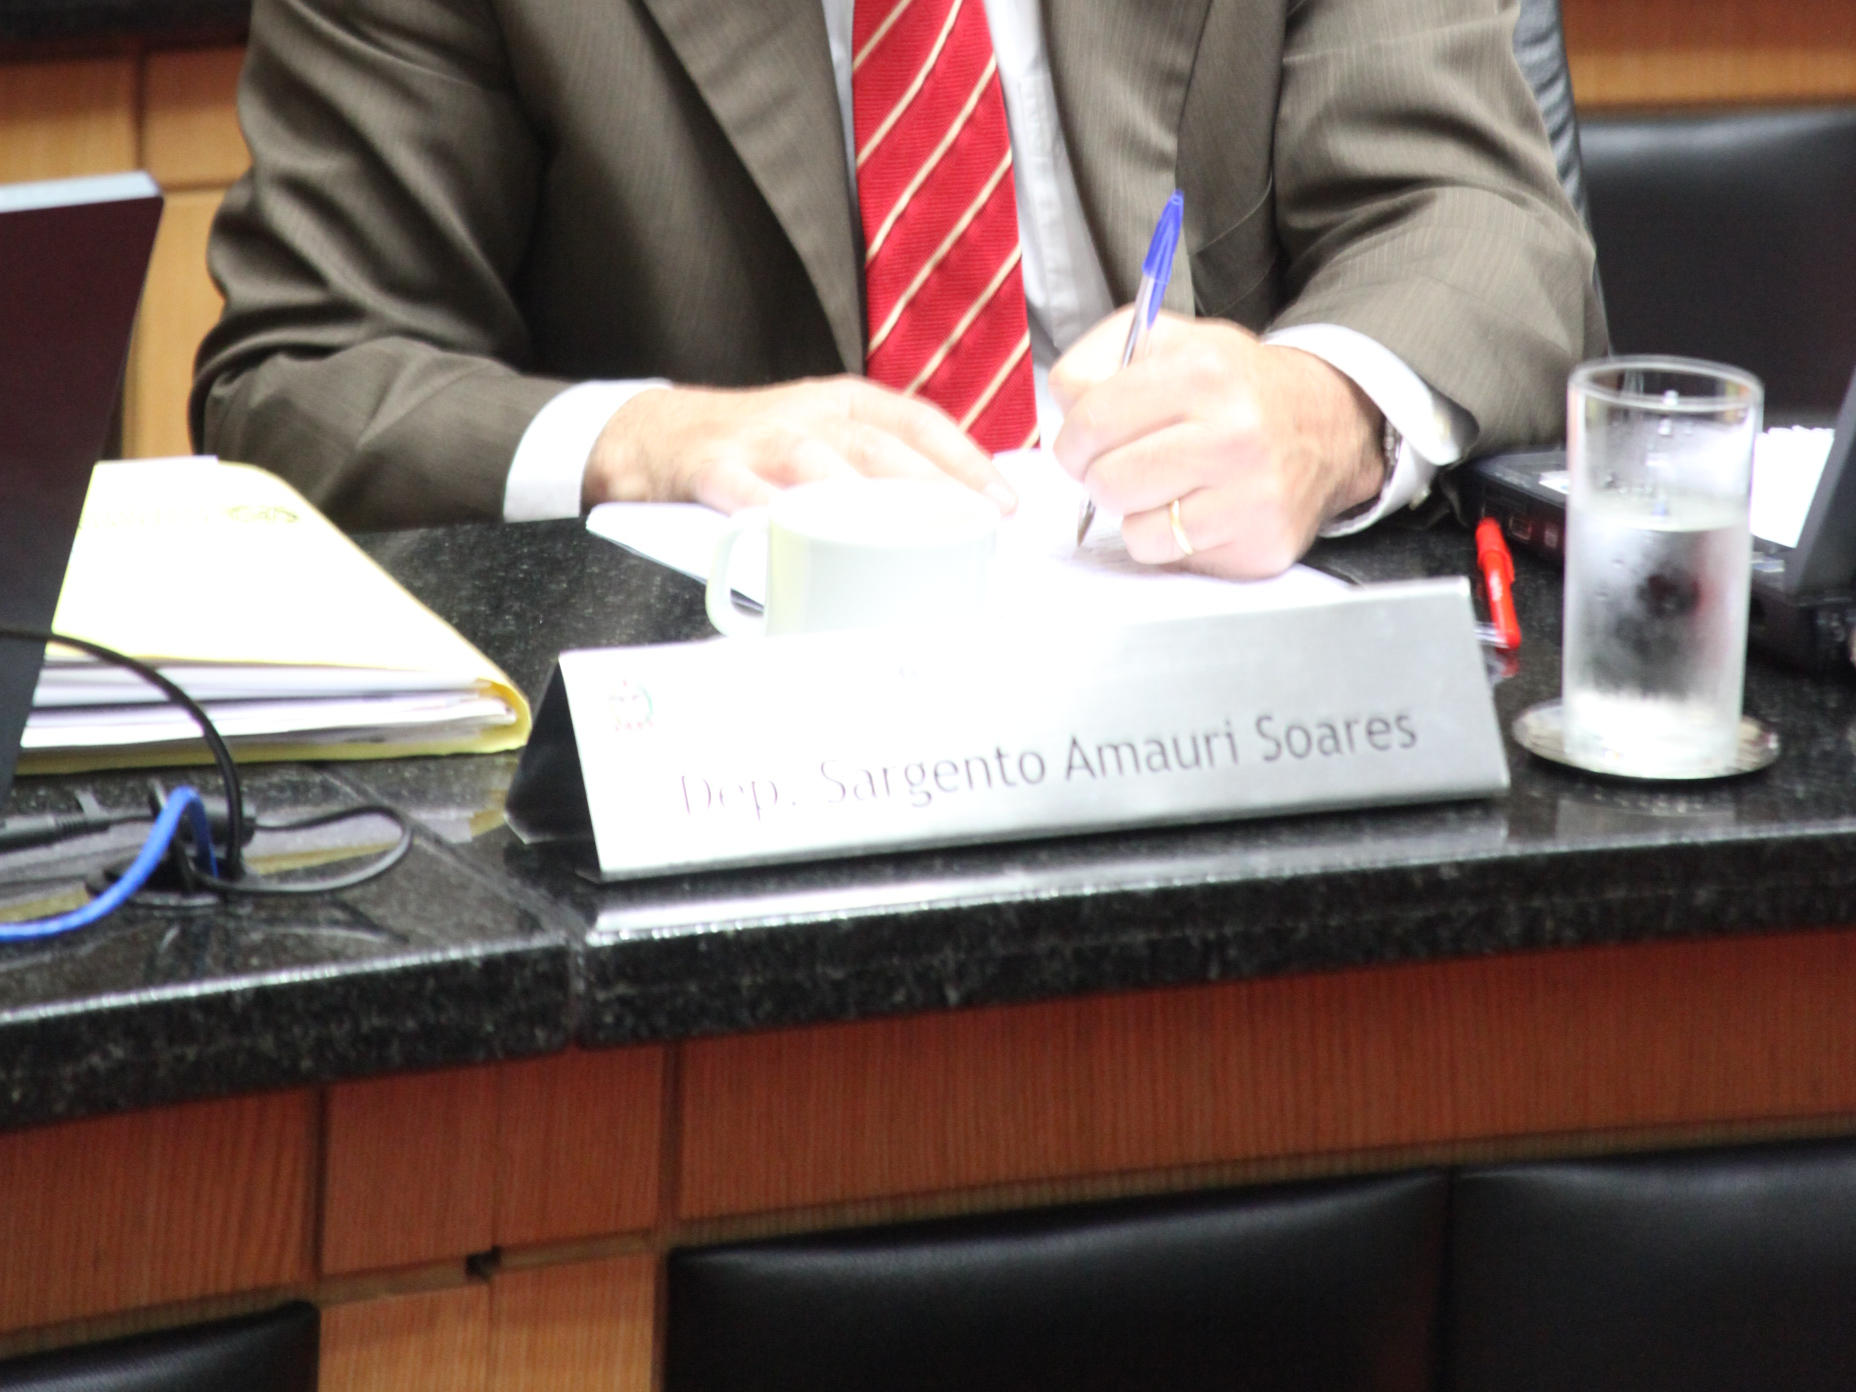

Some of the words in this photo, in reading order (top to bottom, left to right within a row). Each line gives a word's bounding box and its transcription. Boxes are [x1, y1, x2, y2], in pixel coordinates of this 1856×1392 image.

[819, 745, 1046, 809] Sargento
[1064, 719, 1240, 782] Amauri
[1254, 712, 1418, 763] Soares
